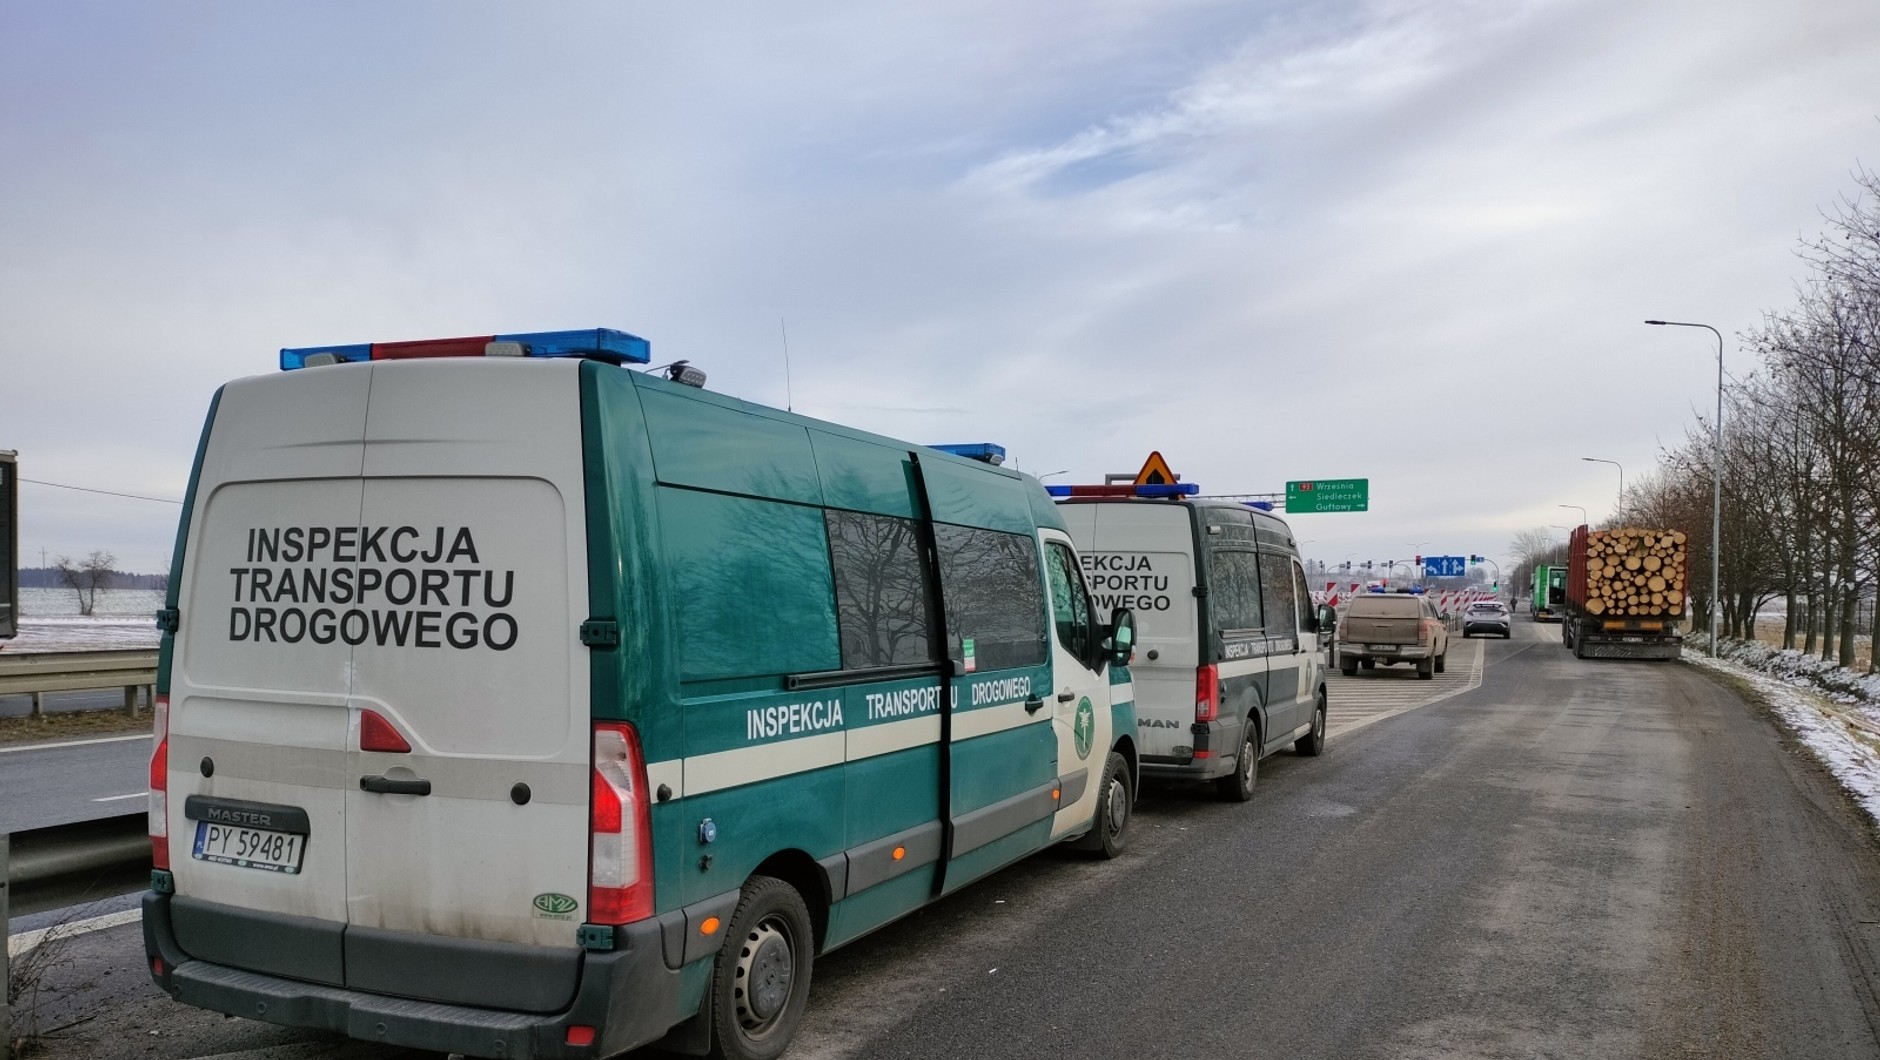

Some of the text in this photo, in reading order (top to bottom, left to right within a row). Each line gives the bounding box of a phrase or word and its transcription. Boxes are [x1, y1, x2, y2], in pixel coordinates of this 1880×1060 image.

[1316, 482, 1354, 490] Września
[1317, 492, 1362, 500] Siedleczek
[247, 526, 480, 563] INSPEKCJA
[230, 567, 514, 608] TRANSPORTU
[229, 607, 518, 651] DROGOWEGO
[747, 699, 844, 740] INSPEKCJA
[971, 676, 1031, 706] DROGOWEGO
[1138, 718, 1179, 729] MAN
[208, 807, 272, 826] MASTER
[207, 826, 294, 864] PY 59481
